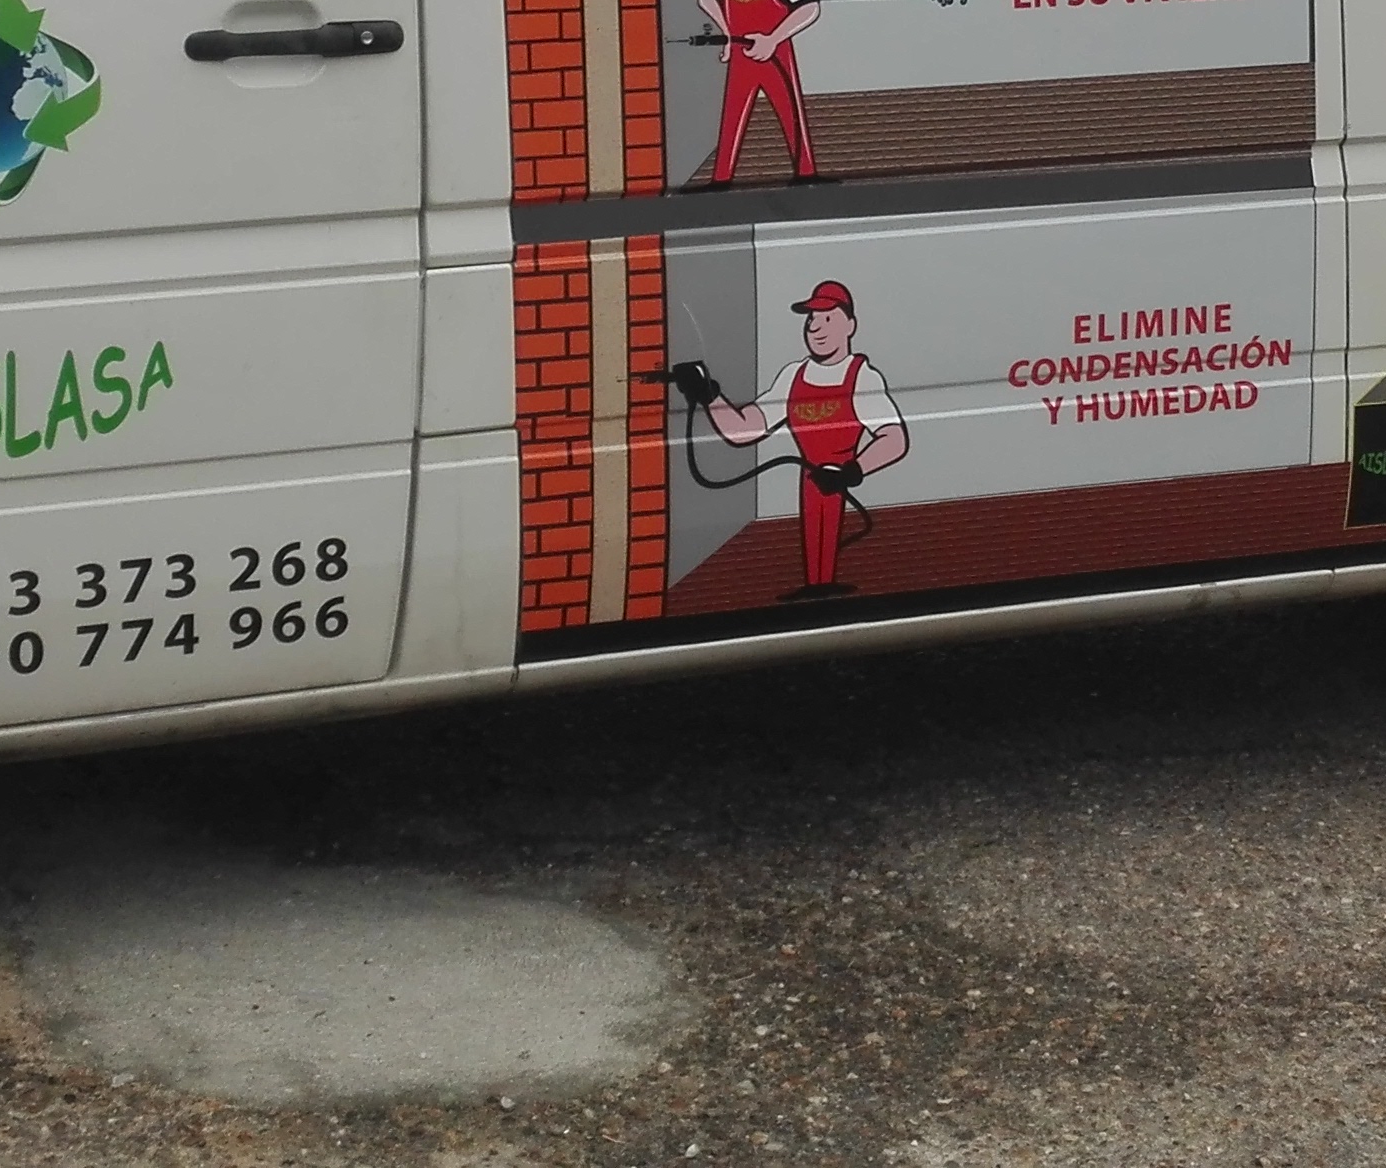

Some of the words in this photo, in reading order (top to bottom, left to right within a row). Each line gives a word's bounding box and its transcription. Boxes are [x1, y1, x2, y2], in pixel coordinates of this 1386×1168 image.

[1074, 304, 1231, 344] ELIMINE
[1007, 336, 1294, 389] CONDENSACIÓN
[1042, 396, 1061, 425] Y
[1075, 381, 1261, 422] HUMEDAD
[76, 554, 196, 608] 373
[230, 538, 348, 591] 268
[77, 614, 199, 667] 774
[230, 596, 348, 649] 966
